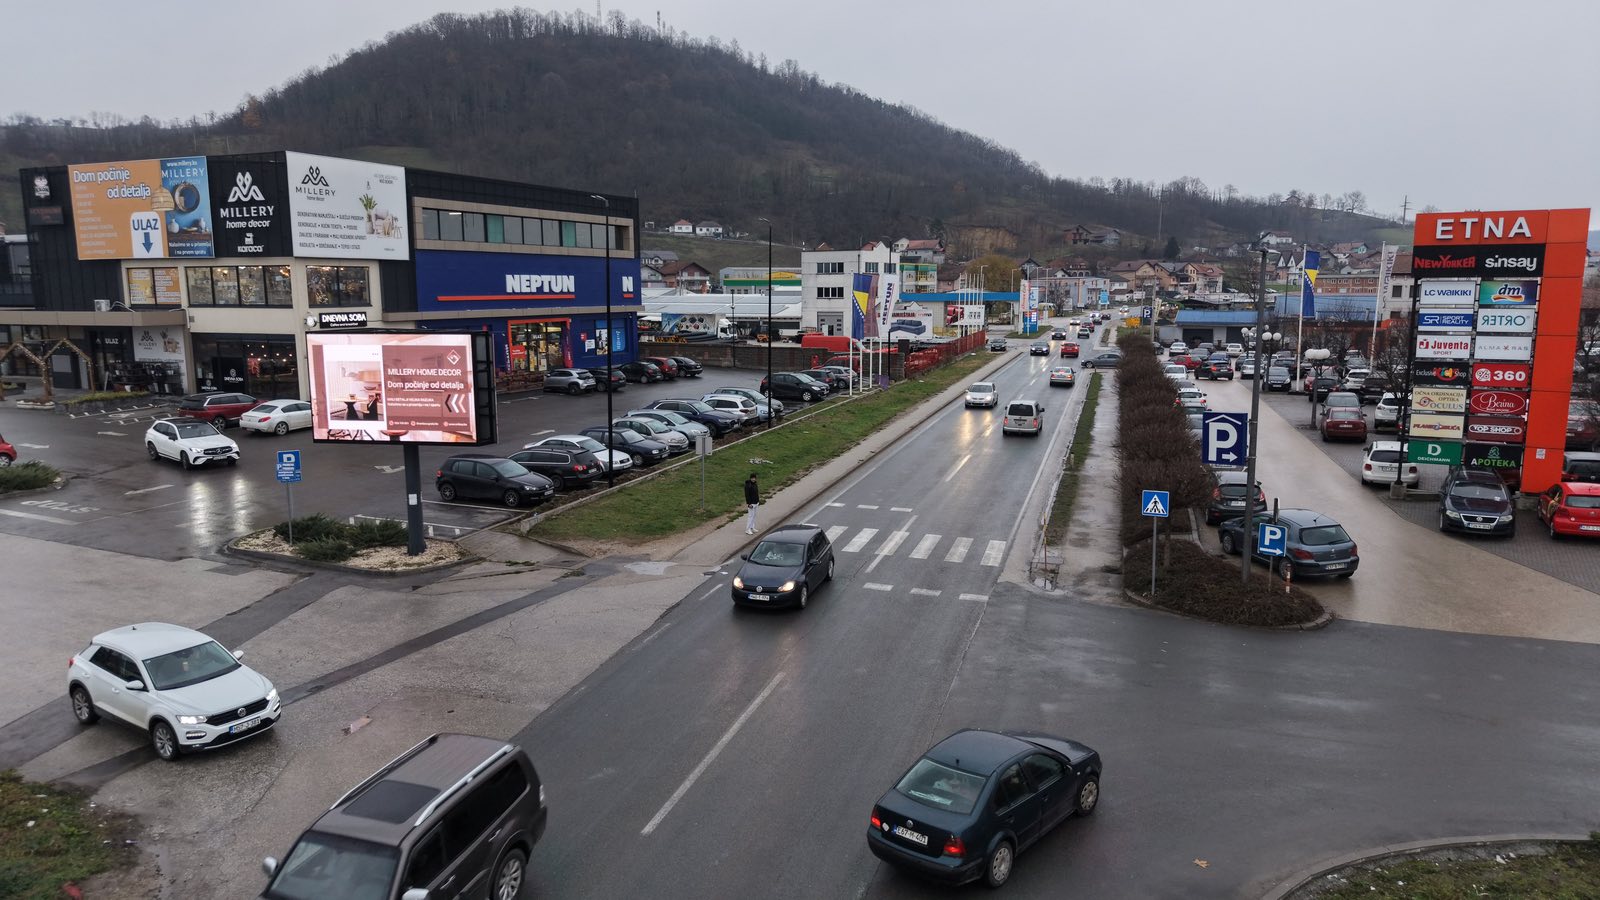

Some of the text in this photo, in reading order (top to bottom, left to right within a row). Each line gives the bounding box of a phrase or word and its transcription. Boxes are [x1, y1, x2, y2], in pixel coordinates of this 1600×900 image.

[73, 167, 130, 184] Dom počinje
[162, 168, 206, 178] MILLERY
[106, 184, 151, 200] od detalja
[296, 186, 336, 196] MILLERY
[220, 206, 274, 218] MILLERY
[132, 218, 159, 231] ULAZ
[1436, 217, 1532, 239] ETNA
[1485, 255, 1537, 271] sinsay
[506, 274, 575, 293] NEPTUN
[622, 276, 633, 292] N
[1499, 284, 1521, 296] dm
[882, 283, 892, 325] NEPTUN
[322, 313, 366, 323] DNEVNA SOBA
[1431, 340, 1468, 350] Juventa
[1493, 370, 1526, 382] 360
[405, 381, 429, 390] počinje
[441, 381, 464, 390] detalja
[1474, 425, 1489, 433] TOP
[1208, 422, 1237, 461] P
[1428, 444, 1441, 455] D
[1471, 459, 1516, 467] APOTEKA
[1264, 526, 1281, 546] P
